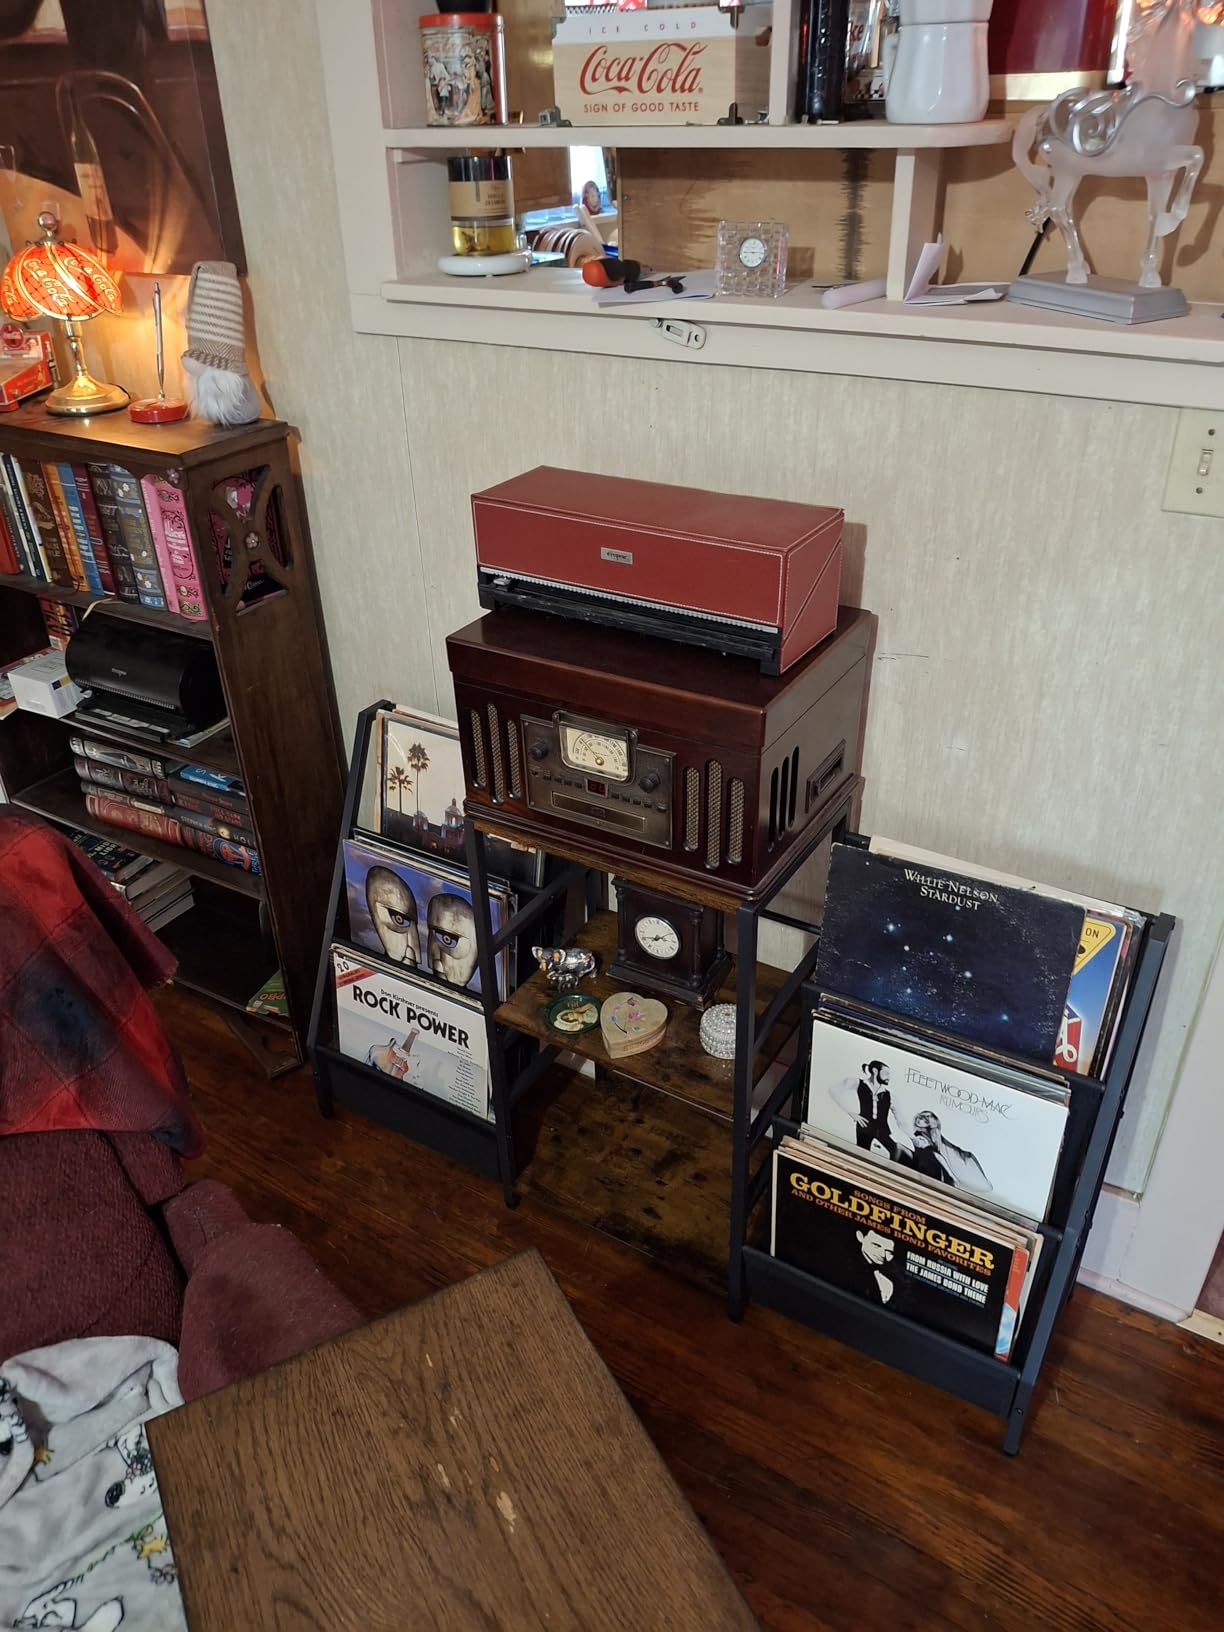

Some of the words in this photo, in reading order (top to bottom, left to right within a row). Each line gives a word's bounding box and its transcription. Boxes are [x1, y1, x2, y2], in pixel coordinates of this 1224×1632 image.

[588, 26, 621, 36] ICE
[644, 21, 697, 32] COLD
[579, 42, 708, 96] Coca-Cola
[584, 103, 608, 113] SIGN
[613, 103, 626, 113] OF
[631, 102, 664, 113] GOOD
[670, 101, 700, 113] TASTE
[904, 868, 945, 889] WILLIE
[948, 880, 1000, 905] NELSON
[920, 885, 981, 911] STARDUST
[336, 961, 350, 973] 20
[352, 984, 401, 1020] ROCK
[406, 1006, 470, 1050] POWER
[380, 988, 392, 999] Don
[415, 1003, 439, 1018] presents
[905, 1067, 980, 1105] FLEETWOOD
[981, 1096, 1013, 1120] MAC
[790, 1172, 995, 1270] GOLDFINGER
[853, 1189, 890, 1211] SONGS
[893, 1202, 927, 1225] FROM
[791, 1187, 814, 1202] AND
[815, 1198, 853, 1219] OTHER
[854, 1215, 891, 1235] JAMES
[893, 1230, 926, 1249] BOND
[928, 1244, 992, 1277] FAVORITES
[906, 1250, 926, 1264] FROM
[926, 1258, 952, 1277] RUSSIA
[952, 1269, 971, 1286] WITH
[971, 1277, 989, 1293] LOVE
[906, 1262, 919, 1275] THE
[919, 1268, 942, 1285] JAMES
[942, 1278, 963, 1294] BOND
[963, 1286, 987, 1304] THEME
